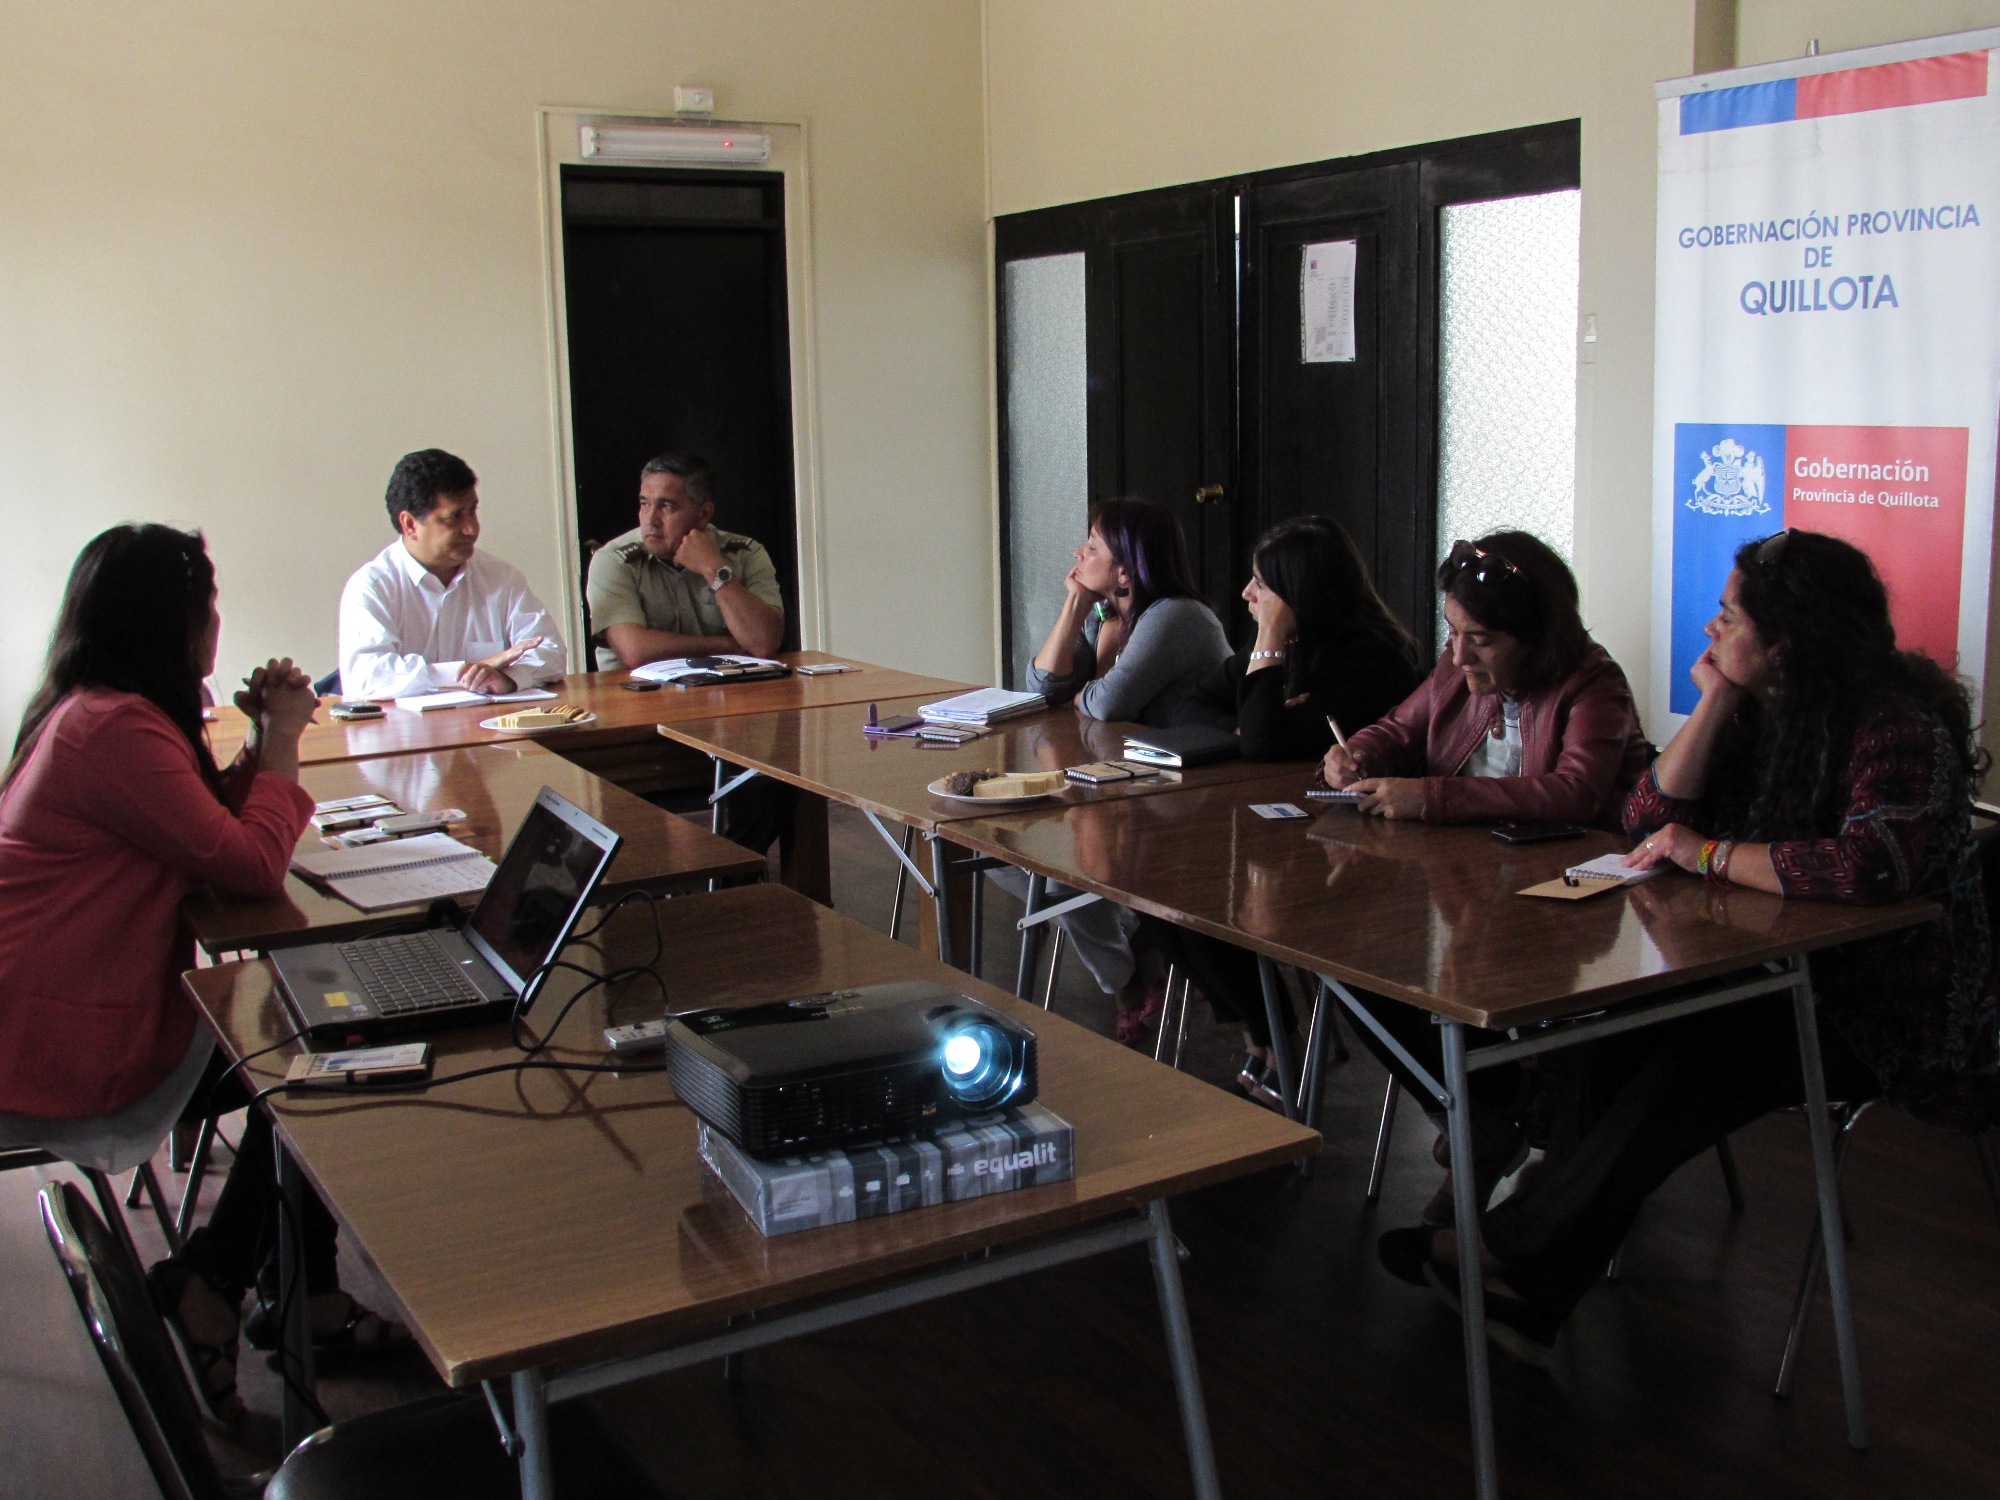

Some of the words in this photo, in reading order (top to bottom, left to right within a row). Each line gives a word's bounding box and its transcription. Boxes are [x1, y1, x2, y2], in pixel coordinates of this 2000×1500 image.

[1678, 210, 1839, 249] GOBERNACIÓN
[1847, 203, 1980, 236] PROVINCIA
[1803, 246, 1833, 269] DE
[1740, 274, 1899, 316] QUILLOTA
[1793, 456, 1930, 482] Gobernación
[1792, 487, 1855, 504] Provincia
[1858, 490, 1874, 505] de
[1877, 491, 1940, 508] Quillota
[973, 1141, 1058, 1180] equalit
